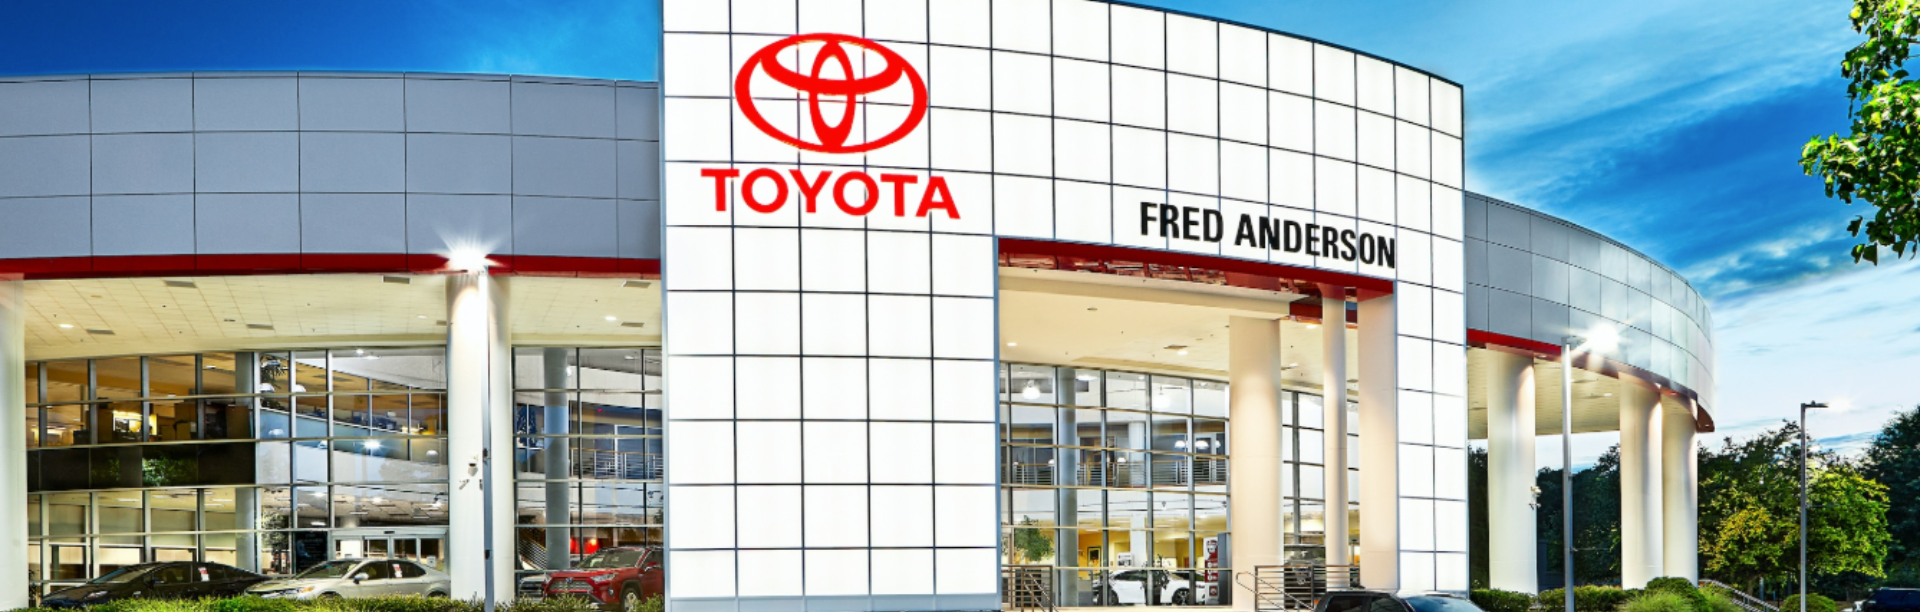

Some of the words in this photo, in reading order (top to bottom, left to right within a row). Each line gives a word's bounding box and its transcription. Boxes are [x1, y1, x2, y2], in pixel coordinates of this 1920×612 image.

[701, 167, 960, 219] TOYOTA
[1140, 201, 1224, 243] FRED
[1234, 213, 1395, 269] ANDERSON
